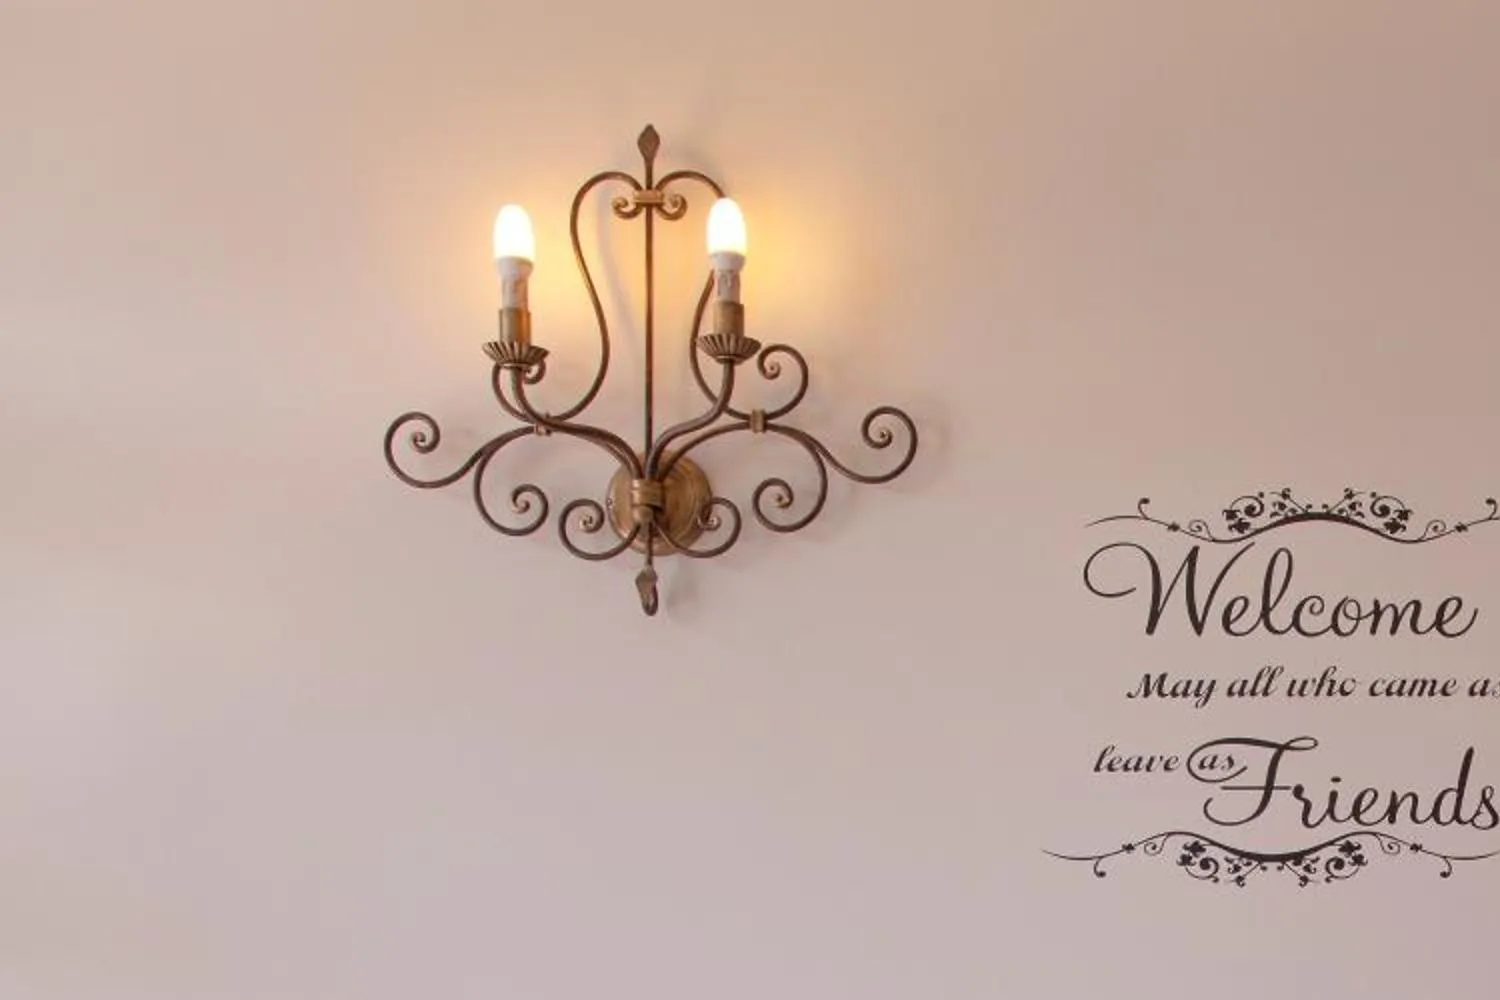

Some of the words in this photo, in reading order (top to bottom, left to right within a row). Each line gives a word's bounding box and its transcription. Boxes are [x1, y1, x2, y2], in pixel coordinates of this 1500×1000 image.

[1083, 541, 1479, 638] Welcome
[1126, 672, 1217, 707] May
[1226, 667, 1284, 698] all
[1286, 667, 1357, 698] who
[1368, 678, 1458, 698] came
[1093, 745, 1180, 774] leave
[1197, 754, 1237, 771] as
[1187, 735, 1500, 830] Friends
